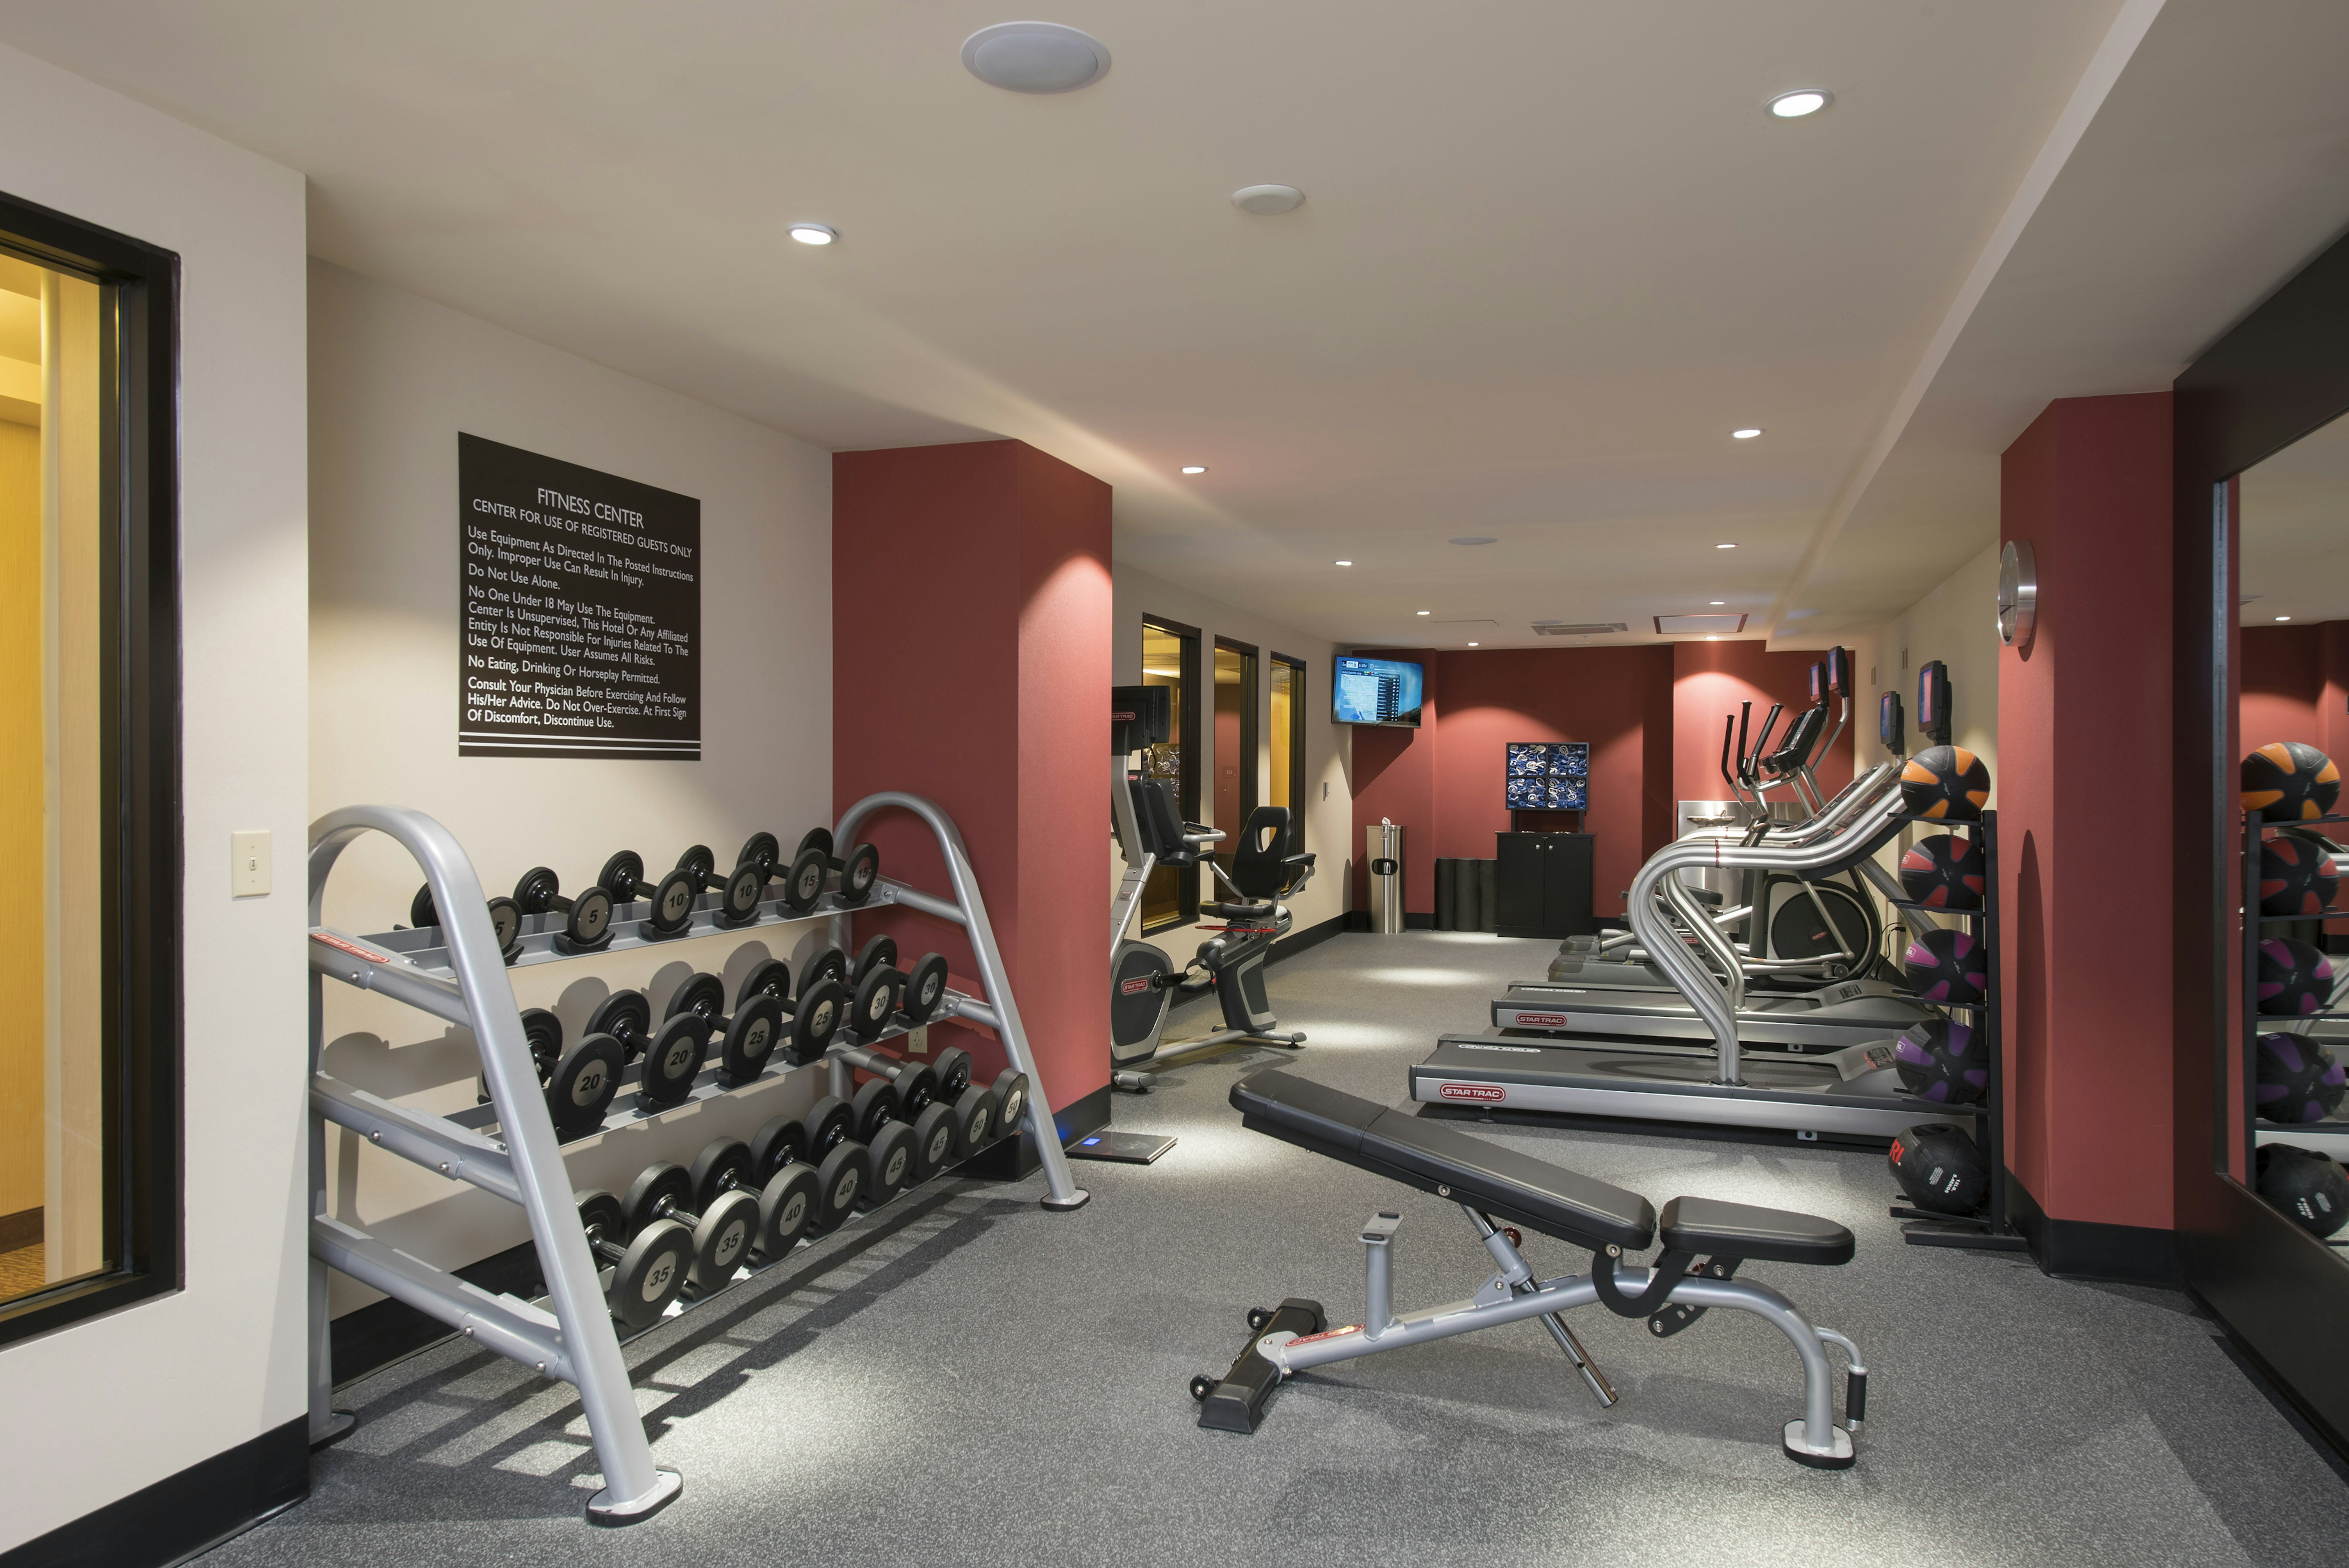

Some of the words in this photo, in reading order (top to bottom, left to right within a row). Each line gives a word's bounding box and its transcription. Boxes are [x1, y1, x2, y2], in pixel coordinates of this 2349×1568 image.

[538, 488, 590, 515] FITNESS
[594, 502, 644, 529] CENTER
[473, 499, 517, 519] CENTER
[520, 509, 542, 525] FOR
[544, 515, 563, 529] USE
[565, 520, 579, 533] OF
[582, 523, 634, 545] REGISTERED
[637, 536, 668, 553] GUESTS
[670, 544, 692, 558] ONLY
[468, 525, 487, 540] Use
[491, 530, 540, 551] Equipment
[542, 541, 554, 554] As
[558, 544, 594, 562] Directed
[597, 552, 604, 564] In
[607, 554, 622, 567] The
[625, 558, 650, 573] Posted
[652, 564, 693, 582] Instructions
[468, 542, 494, 560] Only.
[498, 547, 542, 567] Improper
[544, 556, 561, 570] Use
[564, 560, 581, 574] Can
[584, 564, 609, 579] Result
[611, 569, 618, 581] In
[621, 571, 644, 588] Injury.
[469, 563, 484, 577] Do
[488, 567, 508, 581] Not
[511, 570, 529, 584] Use
[531, 574, 560, 590] Alone.
[469, 584, 485, 599] No
[488, 588, 510, 602] One
[513, 592, 542, 607] Under
[545, 597, 554, 609] 18
[558, 599, 575, 615] May
[577, 602, 593, 615] Use
[595, 605, 611, 618] The
[614, 608, 655, 624] Equipment.
[469, 601, 504, 617] Center
[507, 606, 514, 619] Is
[518, 608, 579, 629] Unsupervised,
[582, 617, 599, 631] This
[602, 620, 624, 634] Hotel
[627, 624, 638, 636] Or
[640, 626, 655, 641] Any
[657, 629, 688, 643] Affiliated
[469, 617, 497, 636] Entity
[501, 621, 508, 634] Is
[512, 623, 531, 636] Not
[534, 625, 585, 643] Responsible
[587, 633, 601, 645] For
[604, 635, 632, 650] Injuries
[634, 639, 661, 653] Related
[663, 643, 673, 654] To
[675, 645, 688, 656] The
[469, 633, 488, 647] Use
[491, 636, 505, 649] Of
[507, 638, 558, 655] Equipment.
[561, 644, 581, 657] User
[583, 647, 619, 661] Assumes
[621, 652, 631, 663] All
[634, 653, 655, 666] Risks.
[468, 654, 485, 668] No
[488, 656, 519, 674] Eating,
[522, 660, 561, 678] Drinking
[563, 664, 576, 676] Or
[579, 666, 619, 683] Horseplay
[622, 670, 660, 684] Permitted.
[468, 676, 507, 691] Consult
[509, 680, 532, 693] Your
[535, 682, 573, 698] Physician
[576, 686, 604, 698] Before
[606, 688, 644, 704] Exercising
[645, 691, 661, 702] And
[663, 693, 686, 704] Follow
[468, 692, 507, 707] His/Her
[509, 696, 543, 709] Advice.
[546, 698, 560, 711] Do
[563, 699, 581, 712] Not
[583, 701, 641, 715] Over-Exercise.
[643, 705, 653, 716] At
[655, 706, 671, 717] First
[673, 707, 687, 720] Sign
[467, 708, 483, 722] Of
[485, 709, 541, 726] Discomfort,
[544, 713, 594, 727] Discontinue
[597, 716, 614, 728] Use.
[804, 875, 815, 886] 15
[858, 868, 868, 879] 15
[740, 885, 752, 897] 10
[670, 893, 684, 908] 10
[589, 909, 598, 923] 5
[320, 935, 350, 948] STAR
[349, 947, 383, 960] TRAC
[925, 982, 935, 995] 30
[875, 996, 886, 1009] 30
[815, 1012, 829, 1026] 25
[749, 1030, 765, 1045] 25
[670, 1049, 688, 1066] 20
[579, 1074, 600, 1092] 20
[1009, 1100, 1018, 1113] 50
[973, 1119, 983, 1132] 50
[933, 1137, 944, 1151] 45
[890, 1157, 902, 1173] 45
[839, 1180, 853, 1196] 40
[785, 1204, 800, 1222] 40
[722, 1232, 739, 1253] 35
[651, 1265, 670, 1286] 35
